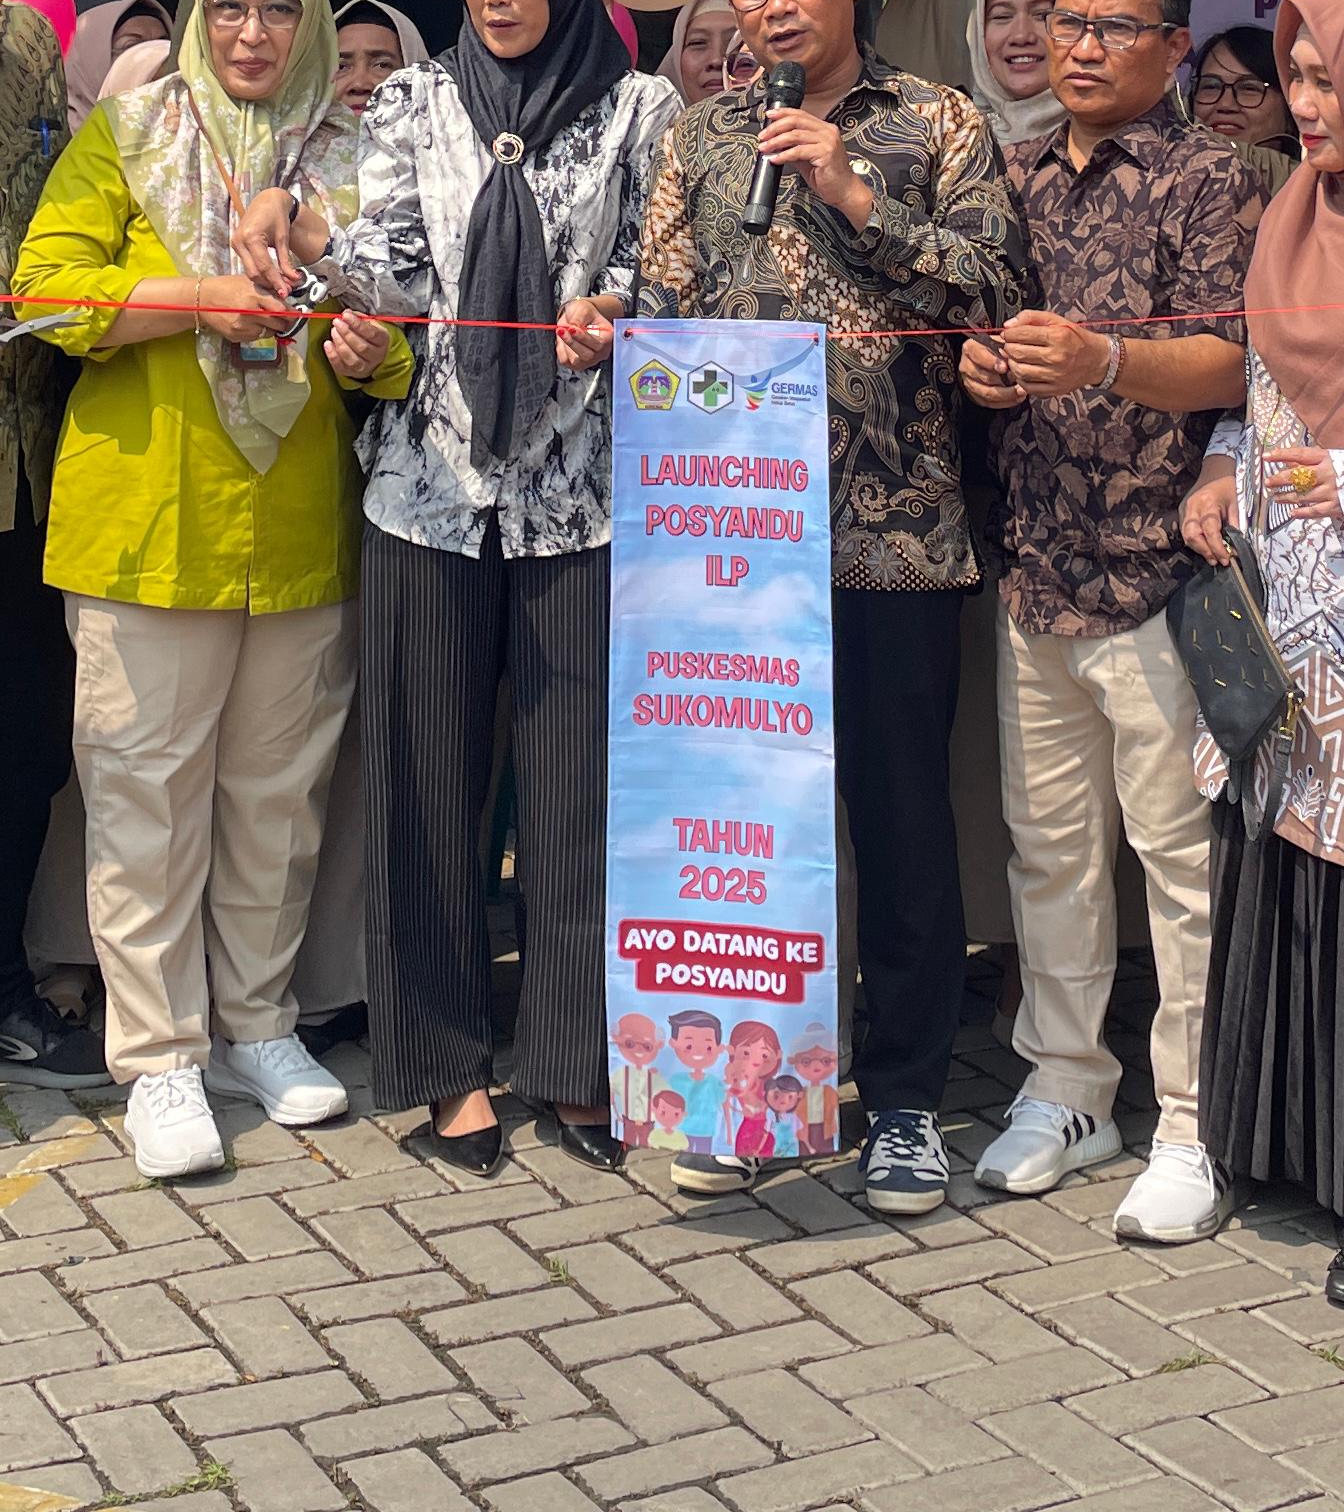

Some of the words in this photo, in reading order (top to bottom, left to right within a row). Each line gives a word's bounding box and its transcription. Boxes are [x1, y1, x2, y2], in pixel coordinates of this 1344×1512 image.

[771, 382, 818, 397] GERMAS
[640, 454, 809, 492] LAUNCHING
[645, 504, 803, 542] POSYANDU
[705, 554, 750, 587] ILP
[646, 651, 800, 687] PUSKESMAS
[632, 694, 813, 735] SUKOMULYO
[672, 818, 774, 859] TAHUN
[678, 865, 767, 905] 2025
[624, 928, 676, 951] AYO
[683, 930, 779, 959] DATANG
[785, 941, 818, 963] KE
[655, 963, 787, 995] POSYANDU
